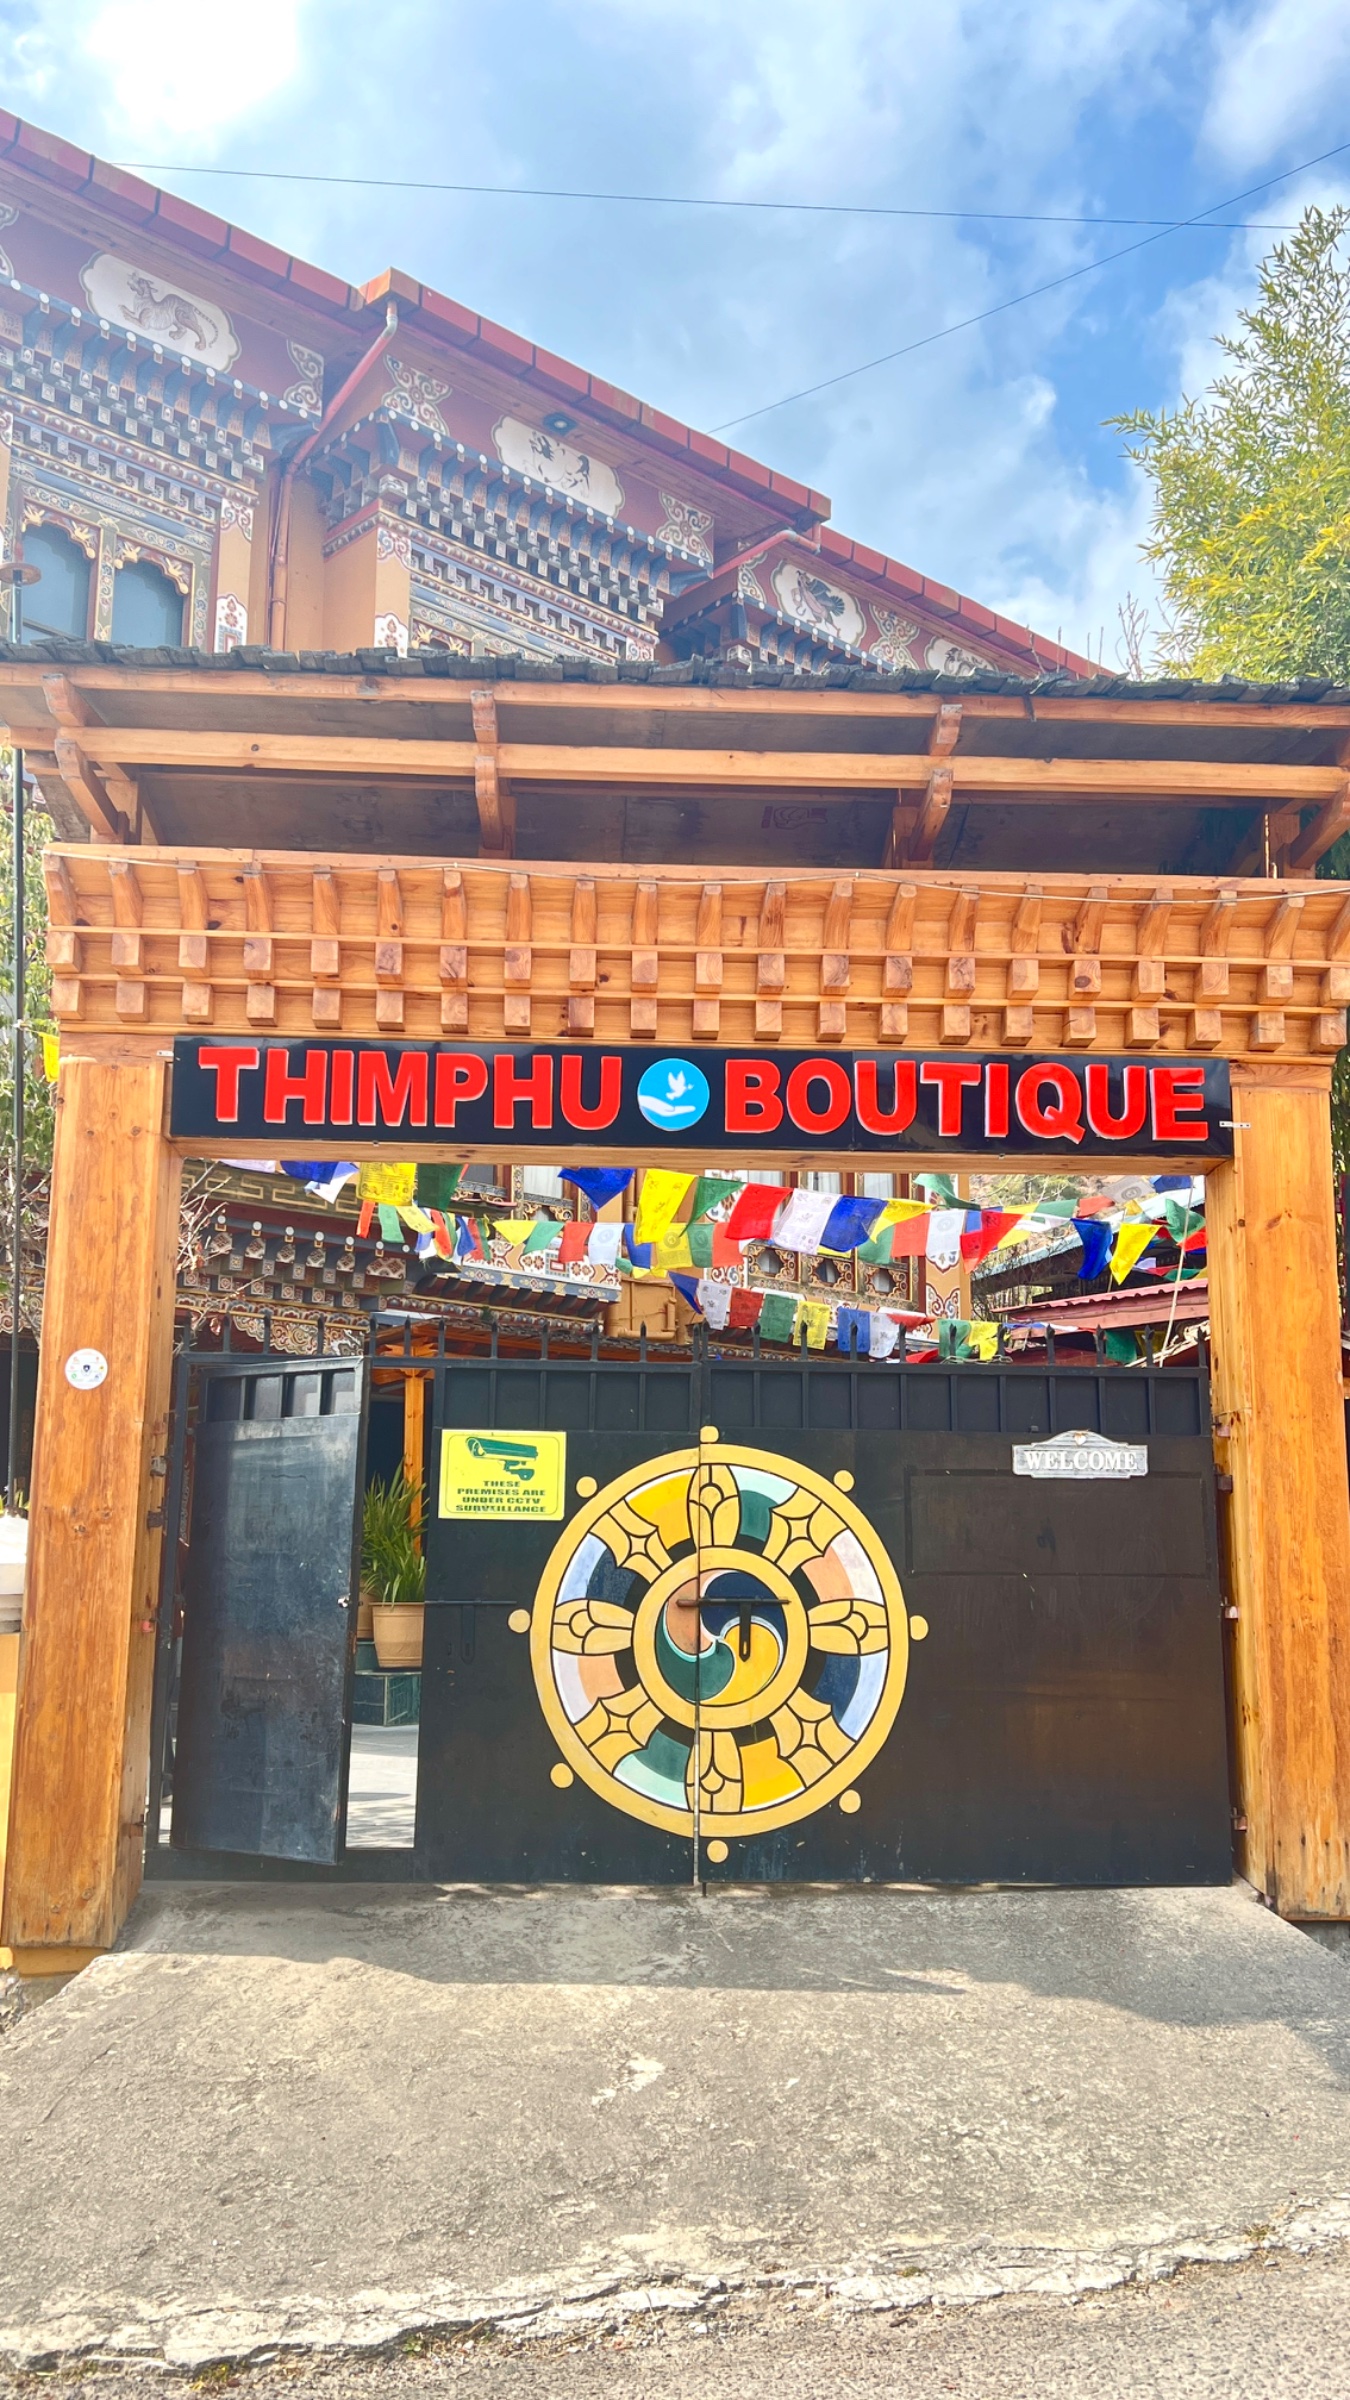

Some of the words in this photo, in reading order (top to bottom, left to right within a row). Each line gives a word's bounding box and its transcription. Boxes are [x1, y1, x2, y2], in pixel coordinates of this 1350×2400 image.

[199, 1046, 623, 1131] THIMPHU
[724, 1058, 1209, 1145] BOUTIQUE
[1023, 1450, 1138, 1470] WELCOME
[457, 1488, 519, 1496] PREMISES
